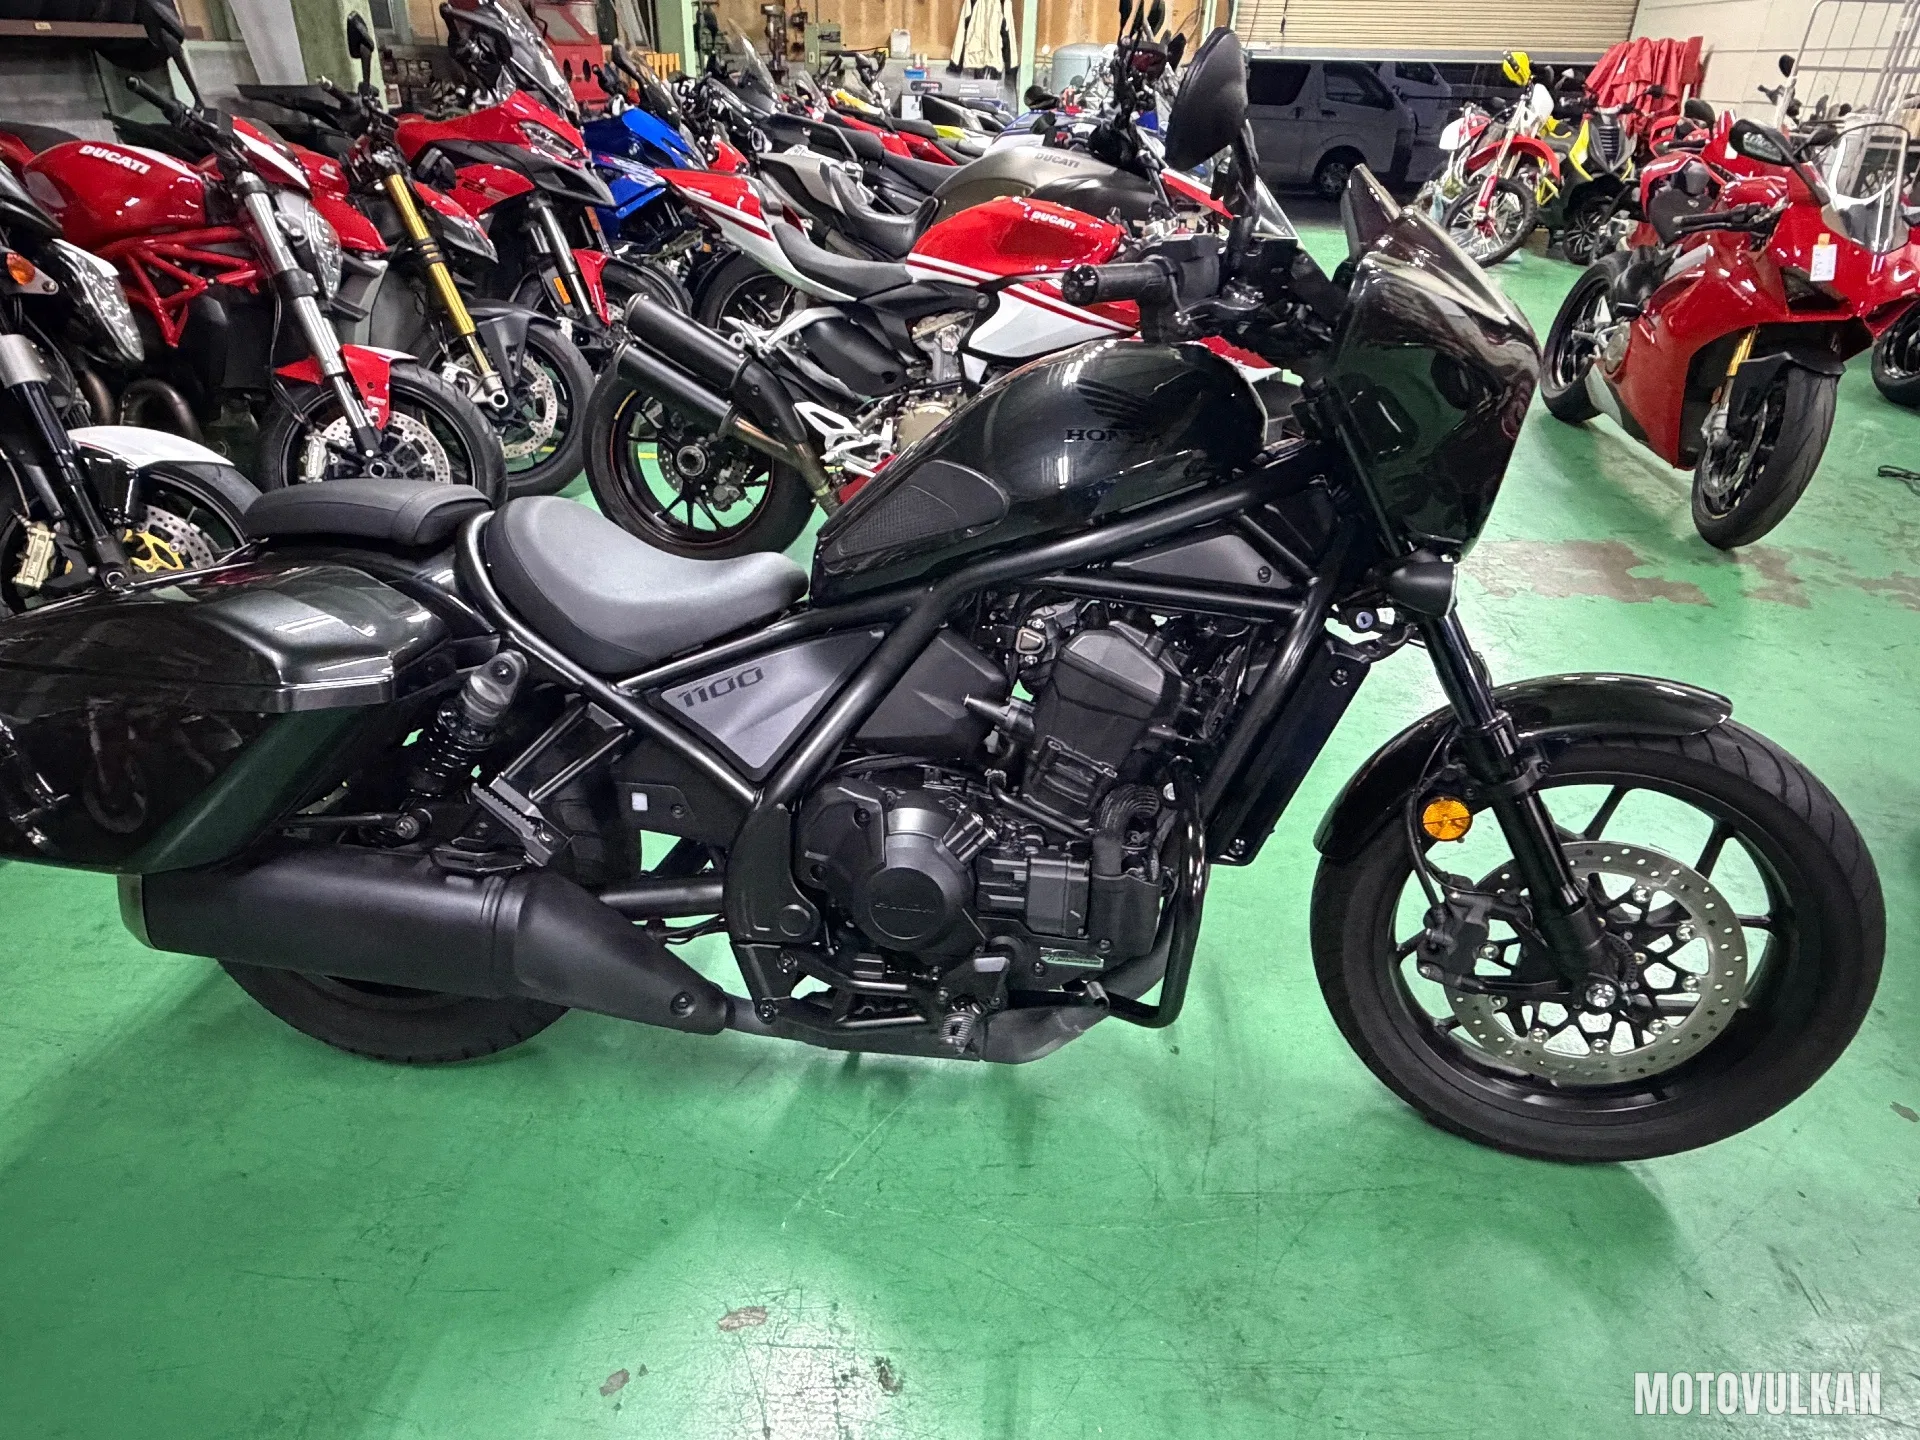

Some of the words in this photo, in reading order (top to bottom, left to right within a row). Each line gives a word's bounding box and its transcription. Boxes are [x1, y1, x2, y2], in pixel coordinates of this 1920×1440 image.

[79, 145, 151, 174] DUCATI
[1034, 153, 1080, 168] DUCATI
[1030, 211, 1077, 230] DUCATI
[677, 667, 764, 707] 1100
